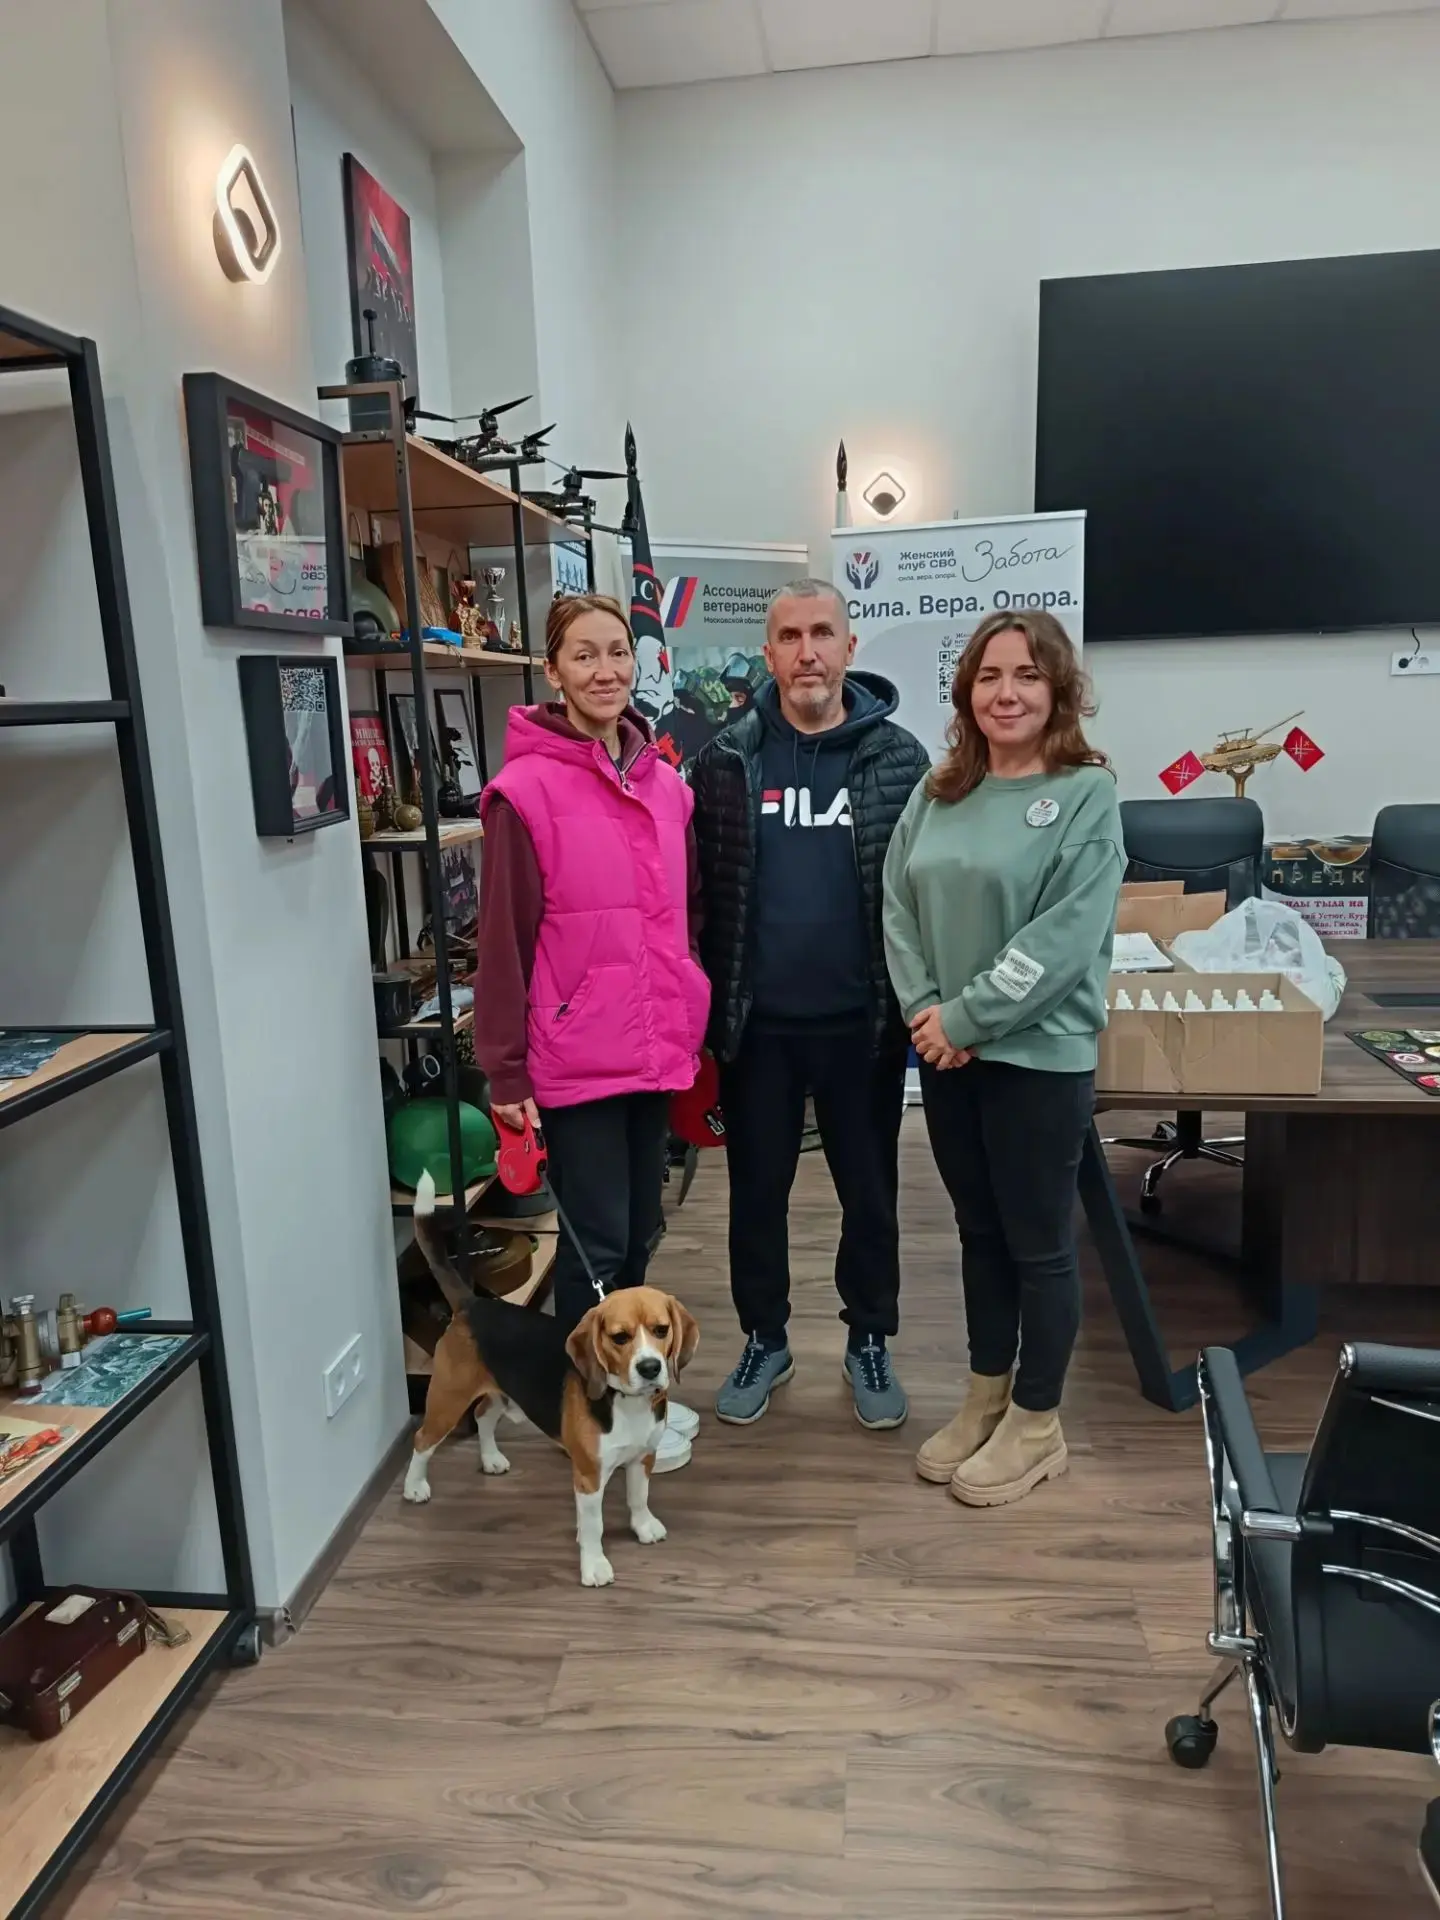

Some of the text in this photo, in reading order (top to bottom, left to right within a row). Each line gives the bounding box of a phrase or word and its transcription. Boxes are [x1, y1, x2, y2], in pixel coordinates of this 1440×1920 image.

[899, 548, 955, 560] Женский
[962, 538, 1076, 582] Забота
[898, 558, 957, 571] клуб СВО
[703, 601, 768, 615] ветеранов
[847, 589, 1079, 619] Сила. Вера. Опора.
[703, 616, 766, 624] Московской област
[761, 787, 854, 827] FILA
